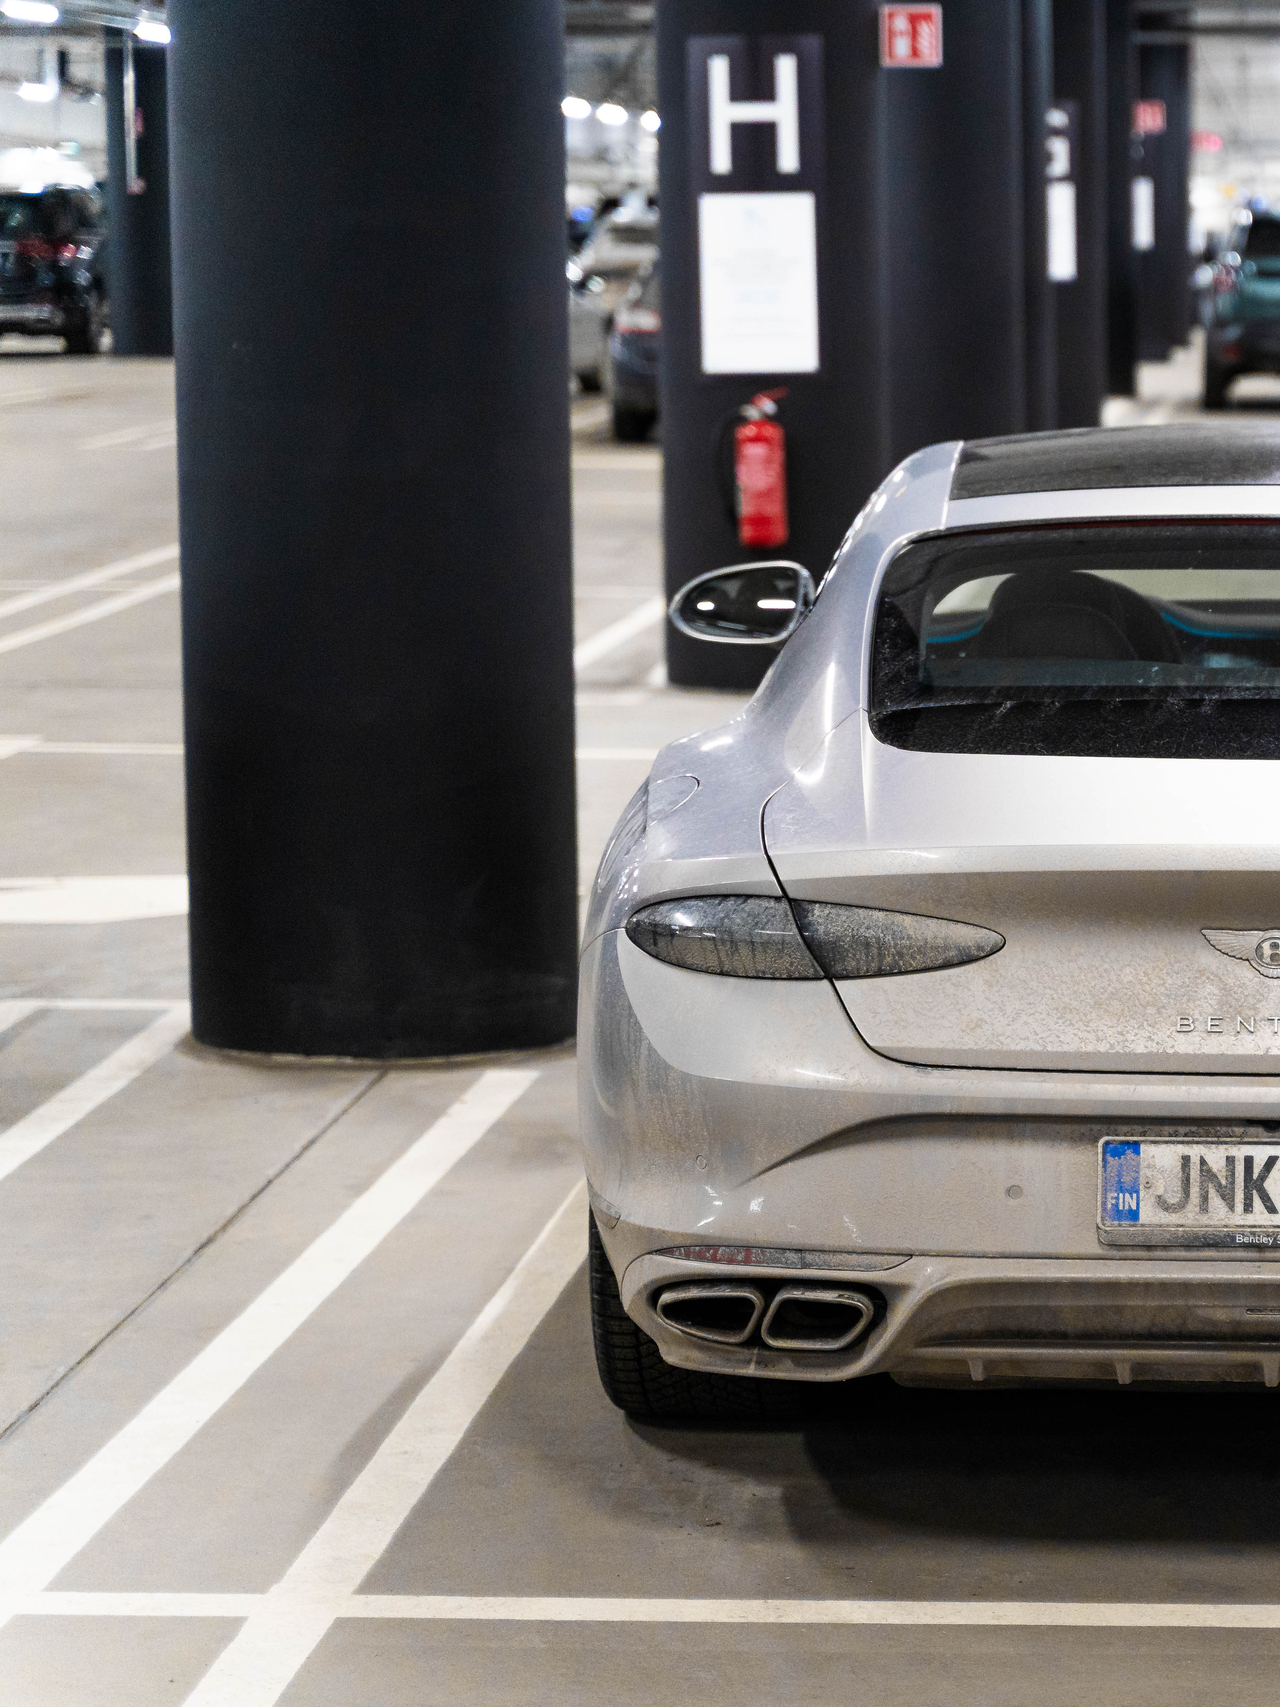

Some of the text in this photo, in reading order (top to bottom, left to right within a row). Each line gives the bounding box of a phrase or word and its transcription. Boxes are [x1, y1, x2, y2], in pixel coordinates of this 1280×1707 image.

[706, 52, 801, 176] H
[1106, 1193, 1138, 1211] FIN
[1235, 1235, 1274, 1246] Bentley
